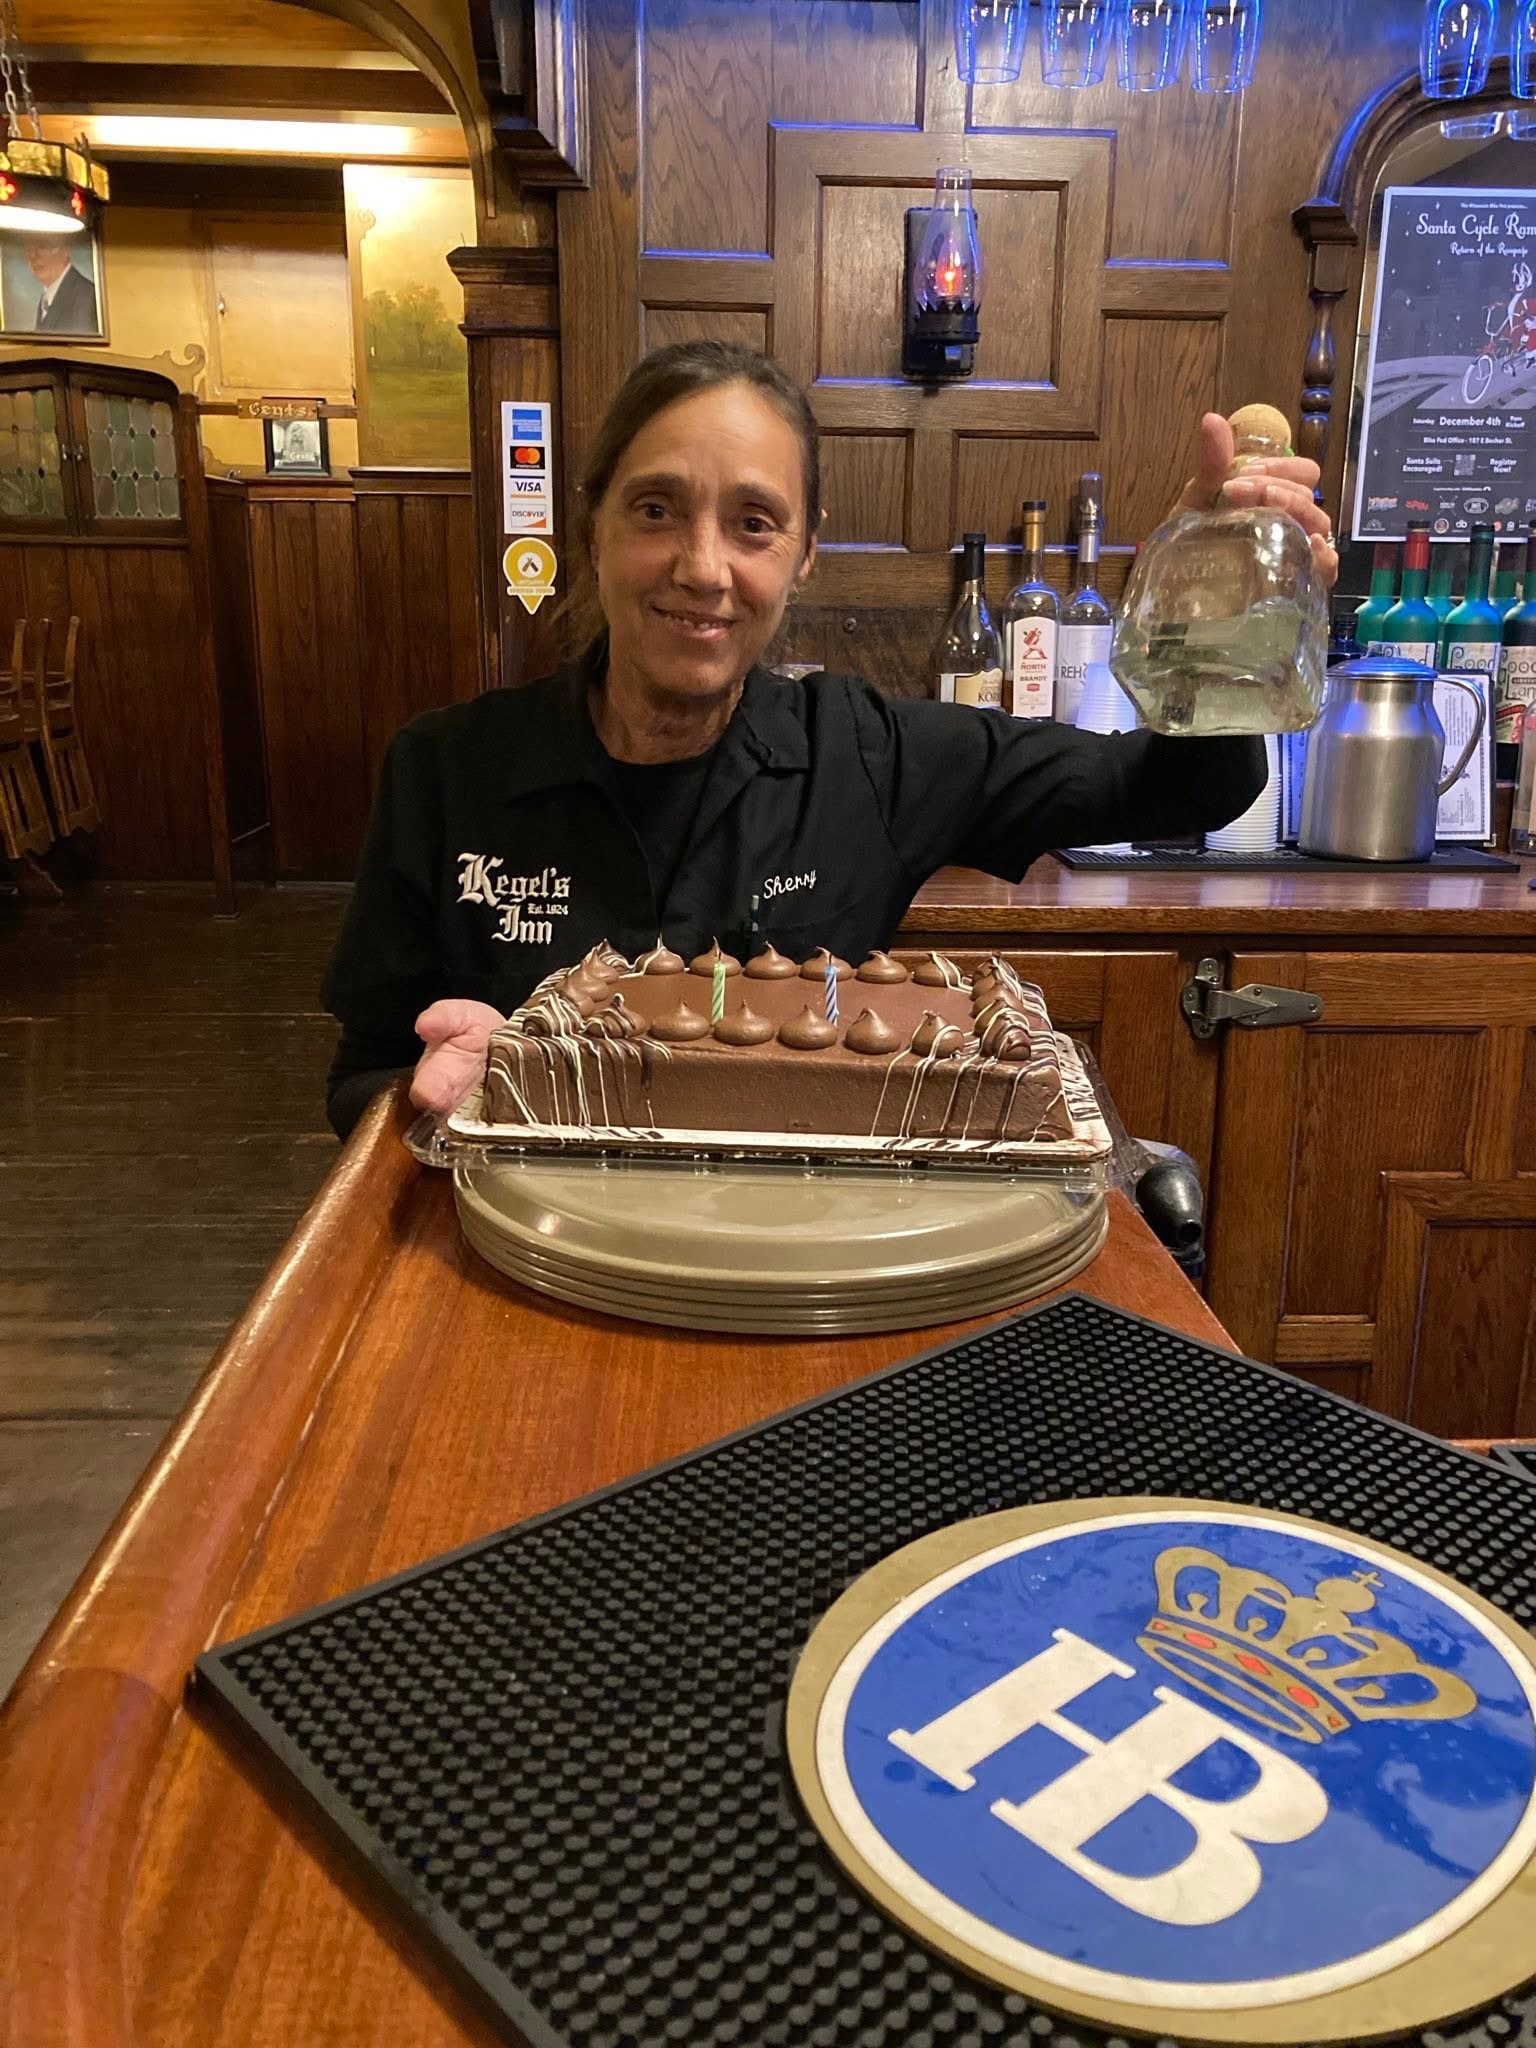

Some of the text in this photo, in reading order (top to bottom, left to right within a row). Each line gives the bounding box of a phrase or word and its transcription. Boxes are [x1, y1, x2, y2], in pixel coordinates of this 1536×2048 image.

[1416, 213, 1457, 235] Santa
[1462, 214, 1499, 241] Cycle
[1450, 242, 1475, 255] Return
[1476, 242, 1484, 257] of
[248, 402, 307, 416] Gents
[1440, 416, 1501, 426] December 4th
[1490, 458, 1517, 466] Register
[515, 482, 542, 492] VISA
[456, 852, 571, 907] Kegel's
[763, 869, 816, 899] Sherry
[491, 904, 553, 945] Inn
[888, 1628, 1329, 1926] HB
